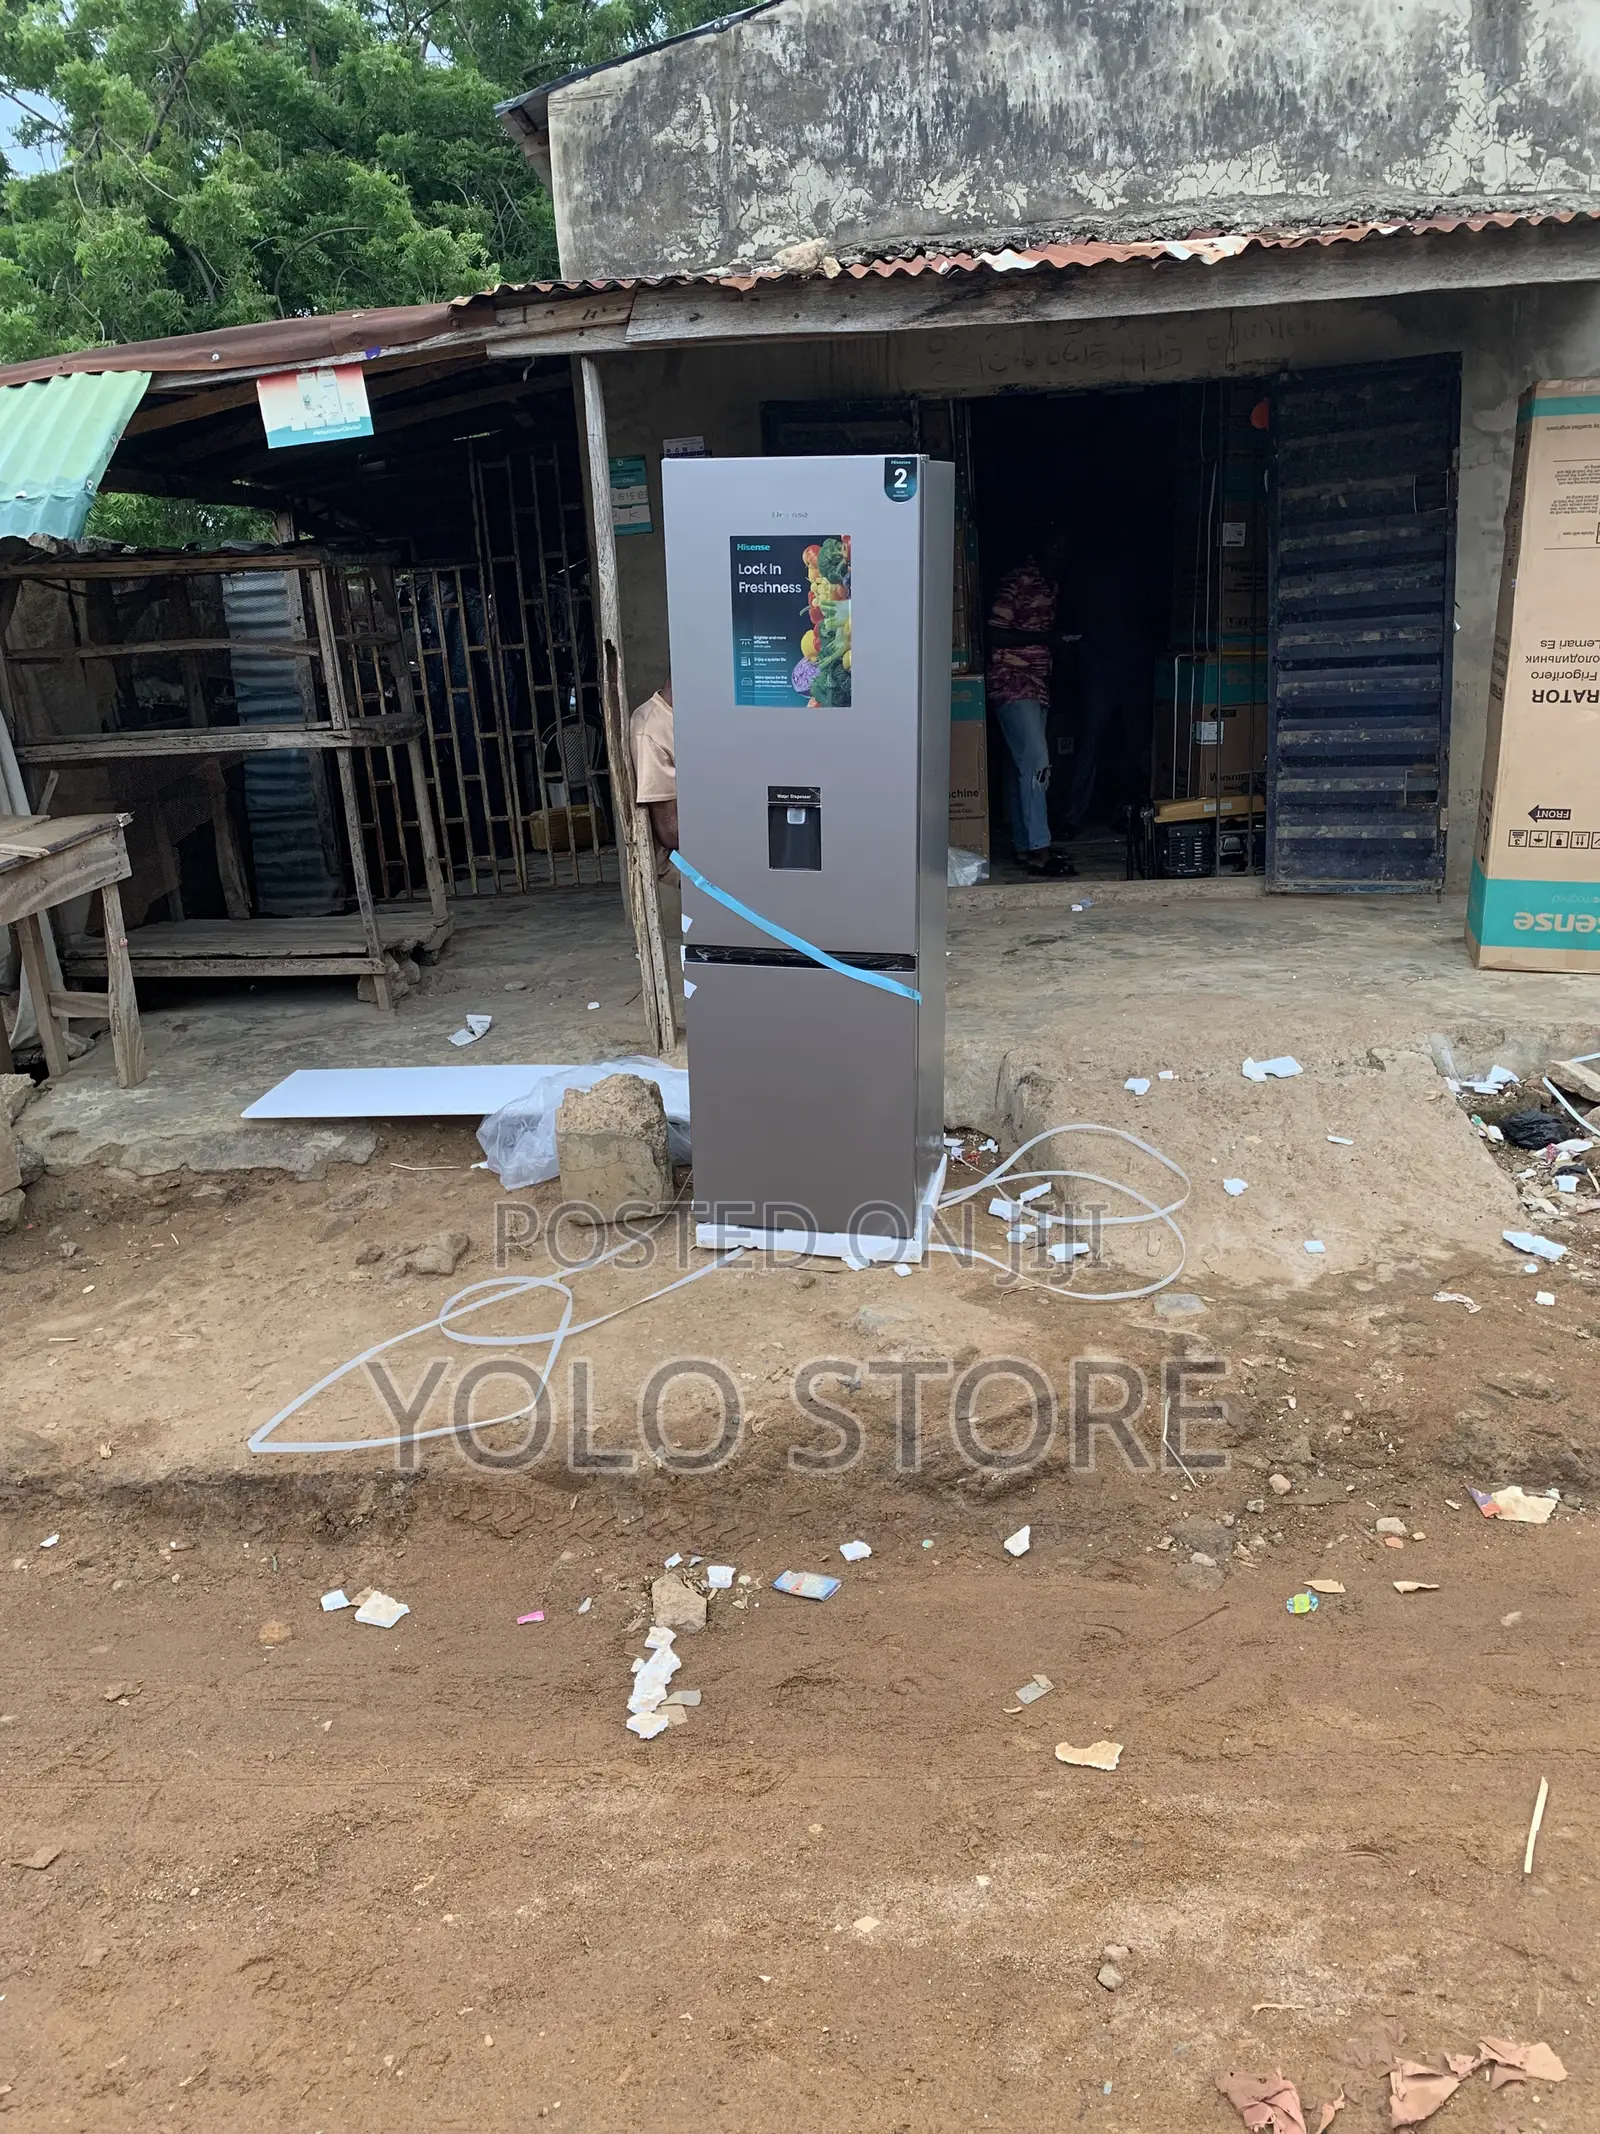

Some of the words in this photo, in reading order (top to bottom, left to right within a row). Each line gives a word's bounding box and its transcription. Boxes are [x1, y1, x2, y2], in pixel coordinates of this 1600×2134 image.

[894, 468, 908, 488] 2
[736, 543, 771, 551] Hisense
[738, 562, 767, 575] Lock
[769, 562, 782, 575] In
[738, 581, 802, 594] Freshness
[1540, 639, 1556, 650] Es
[1530, 669, 1598, 682] Frigorifero
[1531, 689, 1600, 704] RATOR
[1535, 810, 1569, 819] FRONT
[1514, 838, 1521, 846] 3
